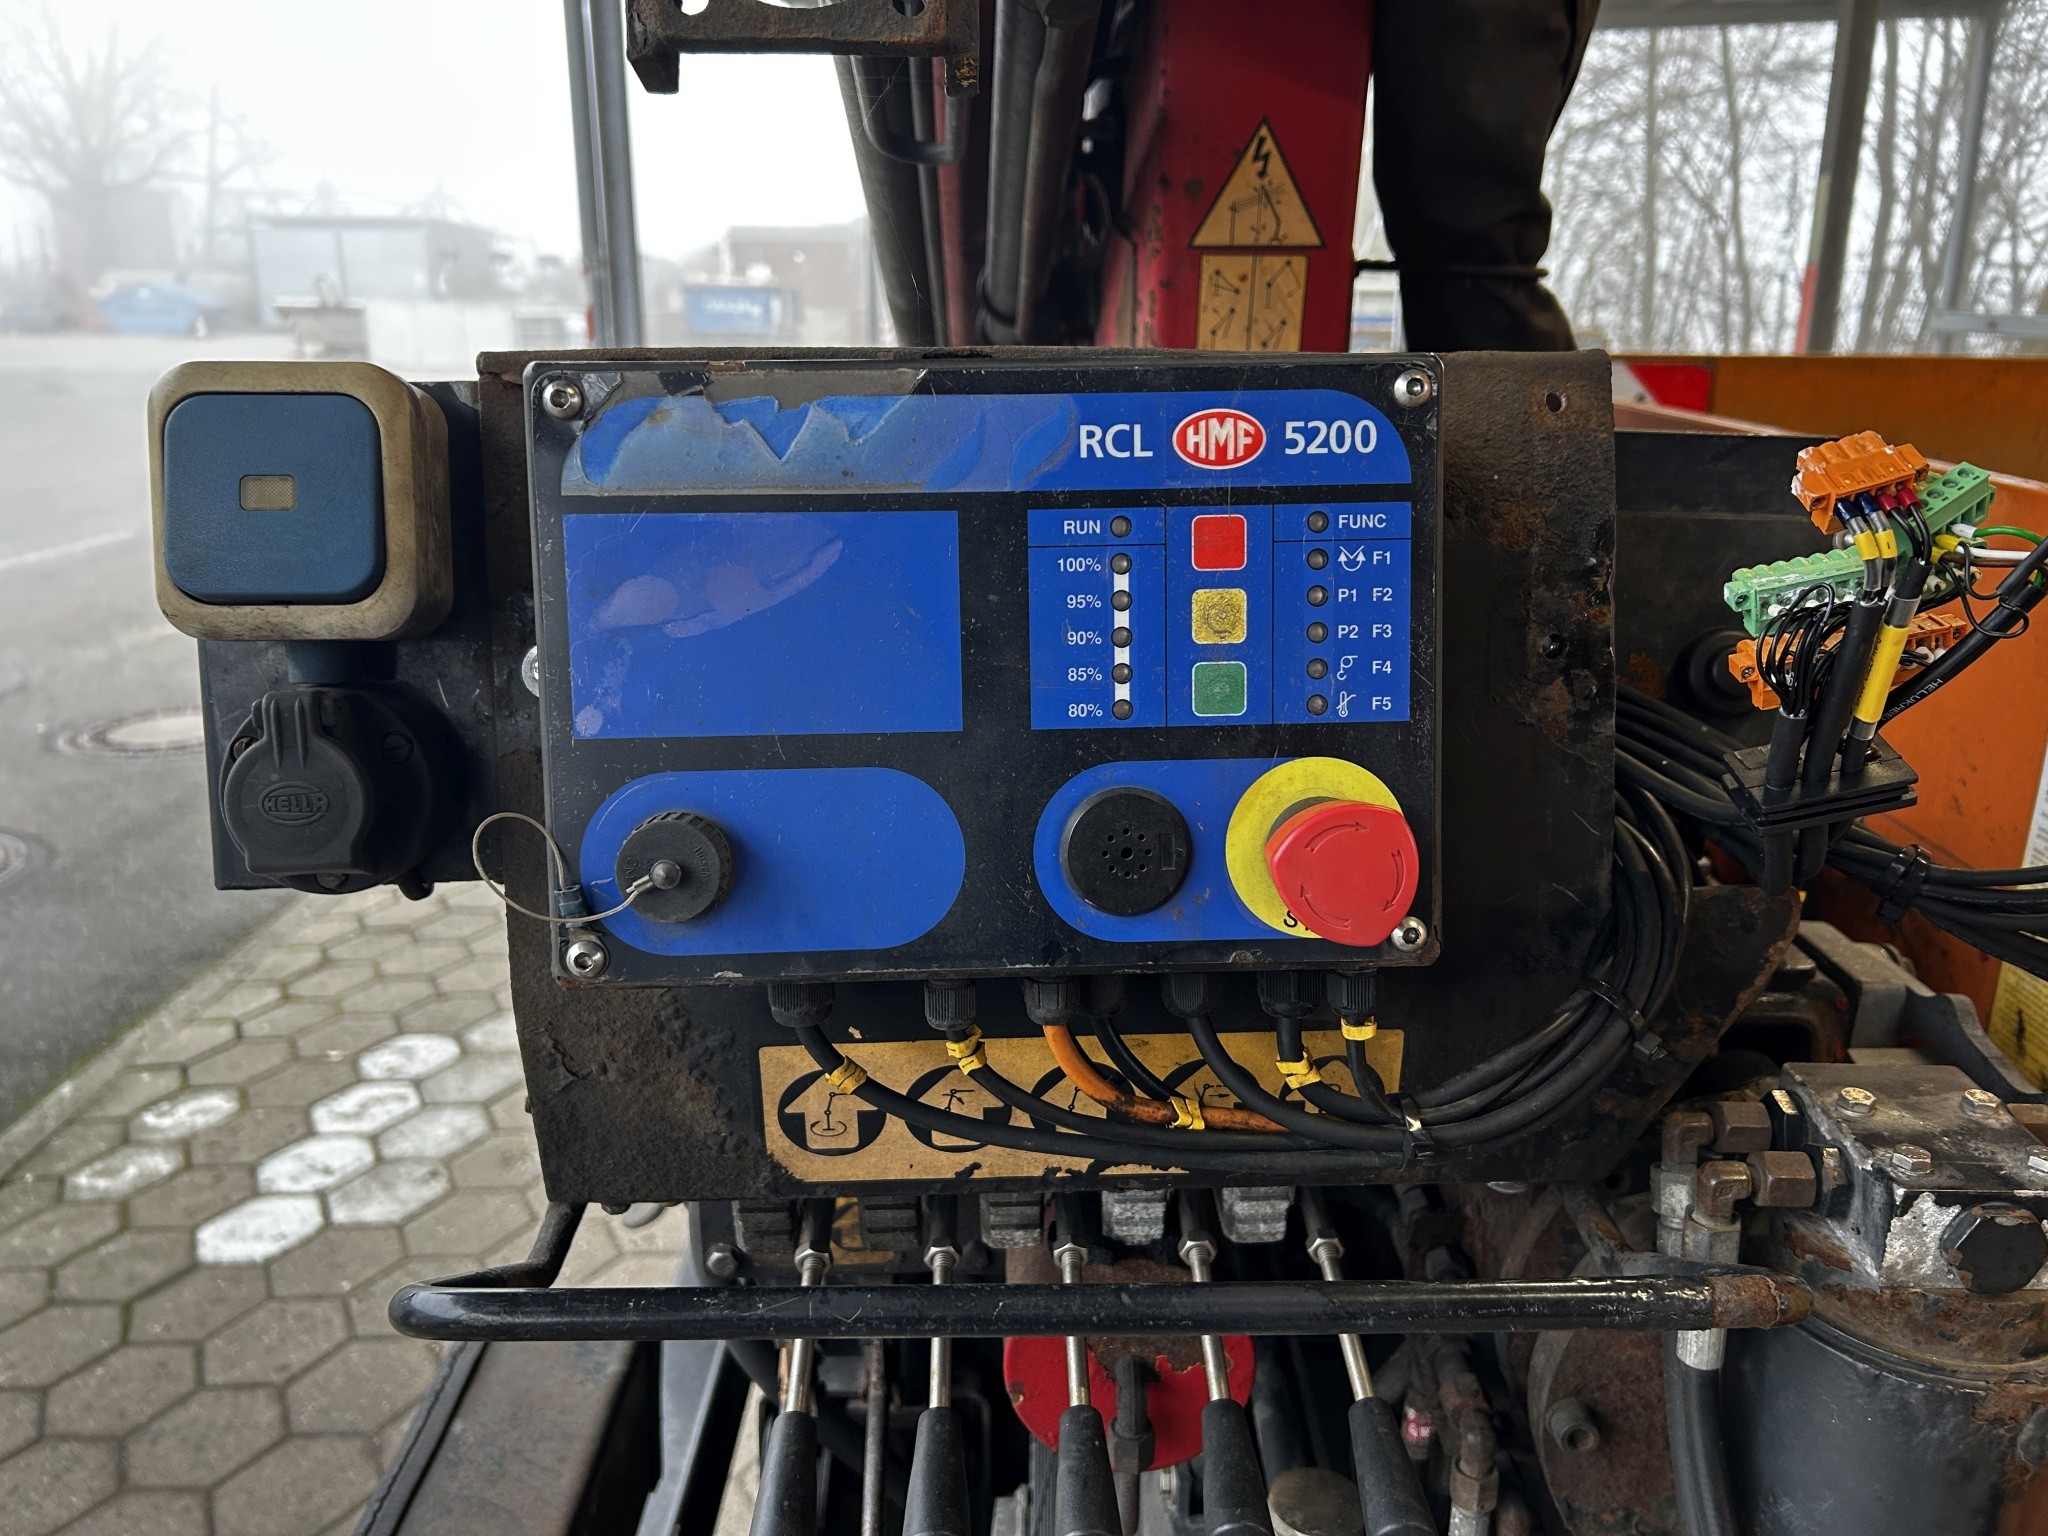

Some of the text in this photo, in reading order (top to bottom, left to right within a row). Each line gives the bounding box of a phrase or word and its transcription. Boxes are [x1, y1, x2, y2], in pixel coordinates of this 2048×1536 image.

[1080, 417, 1376, 461] RCL HMF 5200
[1064, 520, 1100, 534] RUN
[1339, 514, 1386, 528] FUNC
[1374, 551, 1390, 564] F1
[1058, 558, 1101, 571] 100%
[1339, 588, 1392, 601] P1 F2
[1067, 595, 1101, 608] 95%
[1068, 632, 1101, 644] 90%
[1339, 625, 1391, 638] P2 F3
[1373, 661, 1391, 674] F4
[1068, 668, 1102, 681] 85%
[1373, 697, 1391, 710] F5
[1069, 704, 1102, 717] 80%
[263, 794, 329, 813] HELLA
